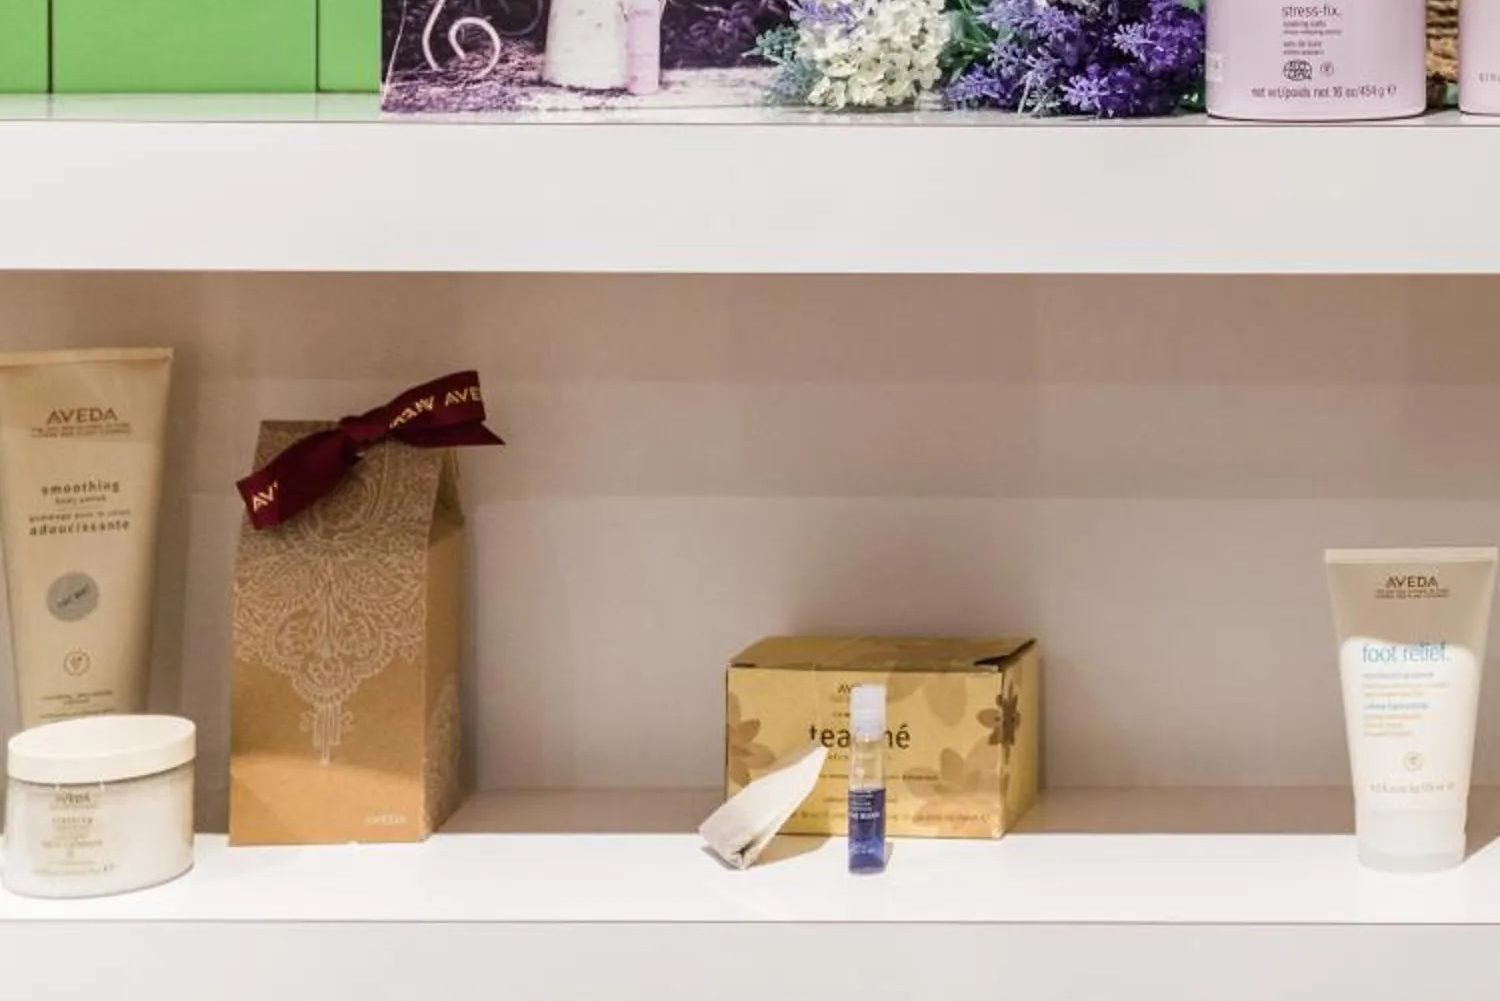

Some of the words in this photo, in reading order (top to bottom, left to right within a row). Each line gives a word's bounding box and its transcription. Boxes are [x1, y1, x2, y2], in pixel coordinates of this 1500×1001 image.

[47, 407, 119, 425] AVEDA
[41, 479, 121, 497] smoothing
[252, 480, 279, 512] AV
[1385, 575, 1439, 588] AVEDA
[1362, 642, 1398, 665] foot
